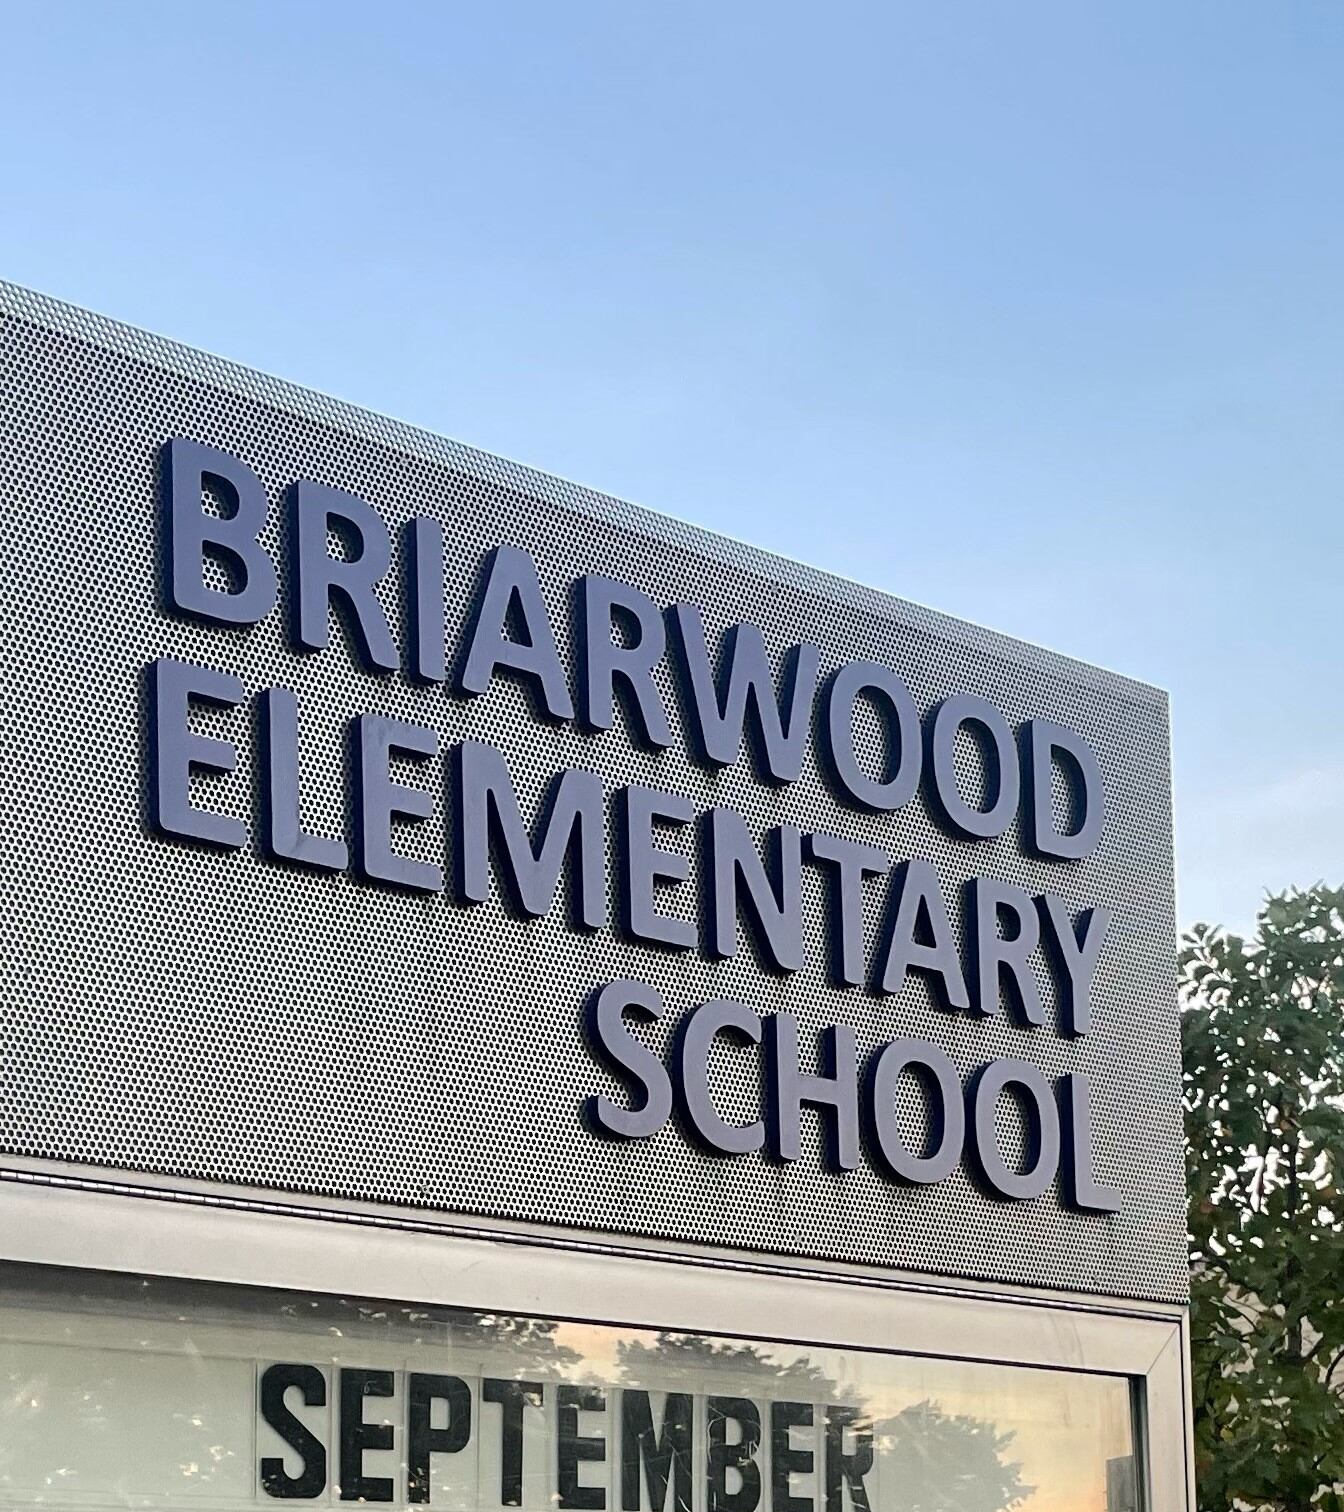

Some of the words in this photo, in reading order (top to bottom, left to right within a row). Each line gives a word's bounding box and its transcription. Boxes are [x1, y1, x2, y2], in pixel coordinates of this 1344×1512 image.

[160, 435, 1104, 861] BRIARWOOD
[147, 657, 1111, 1037] ELEMENTARY
[584, 978, 1122, 1213] SCHOOL
